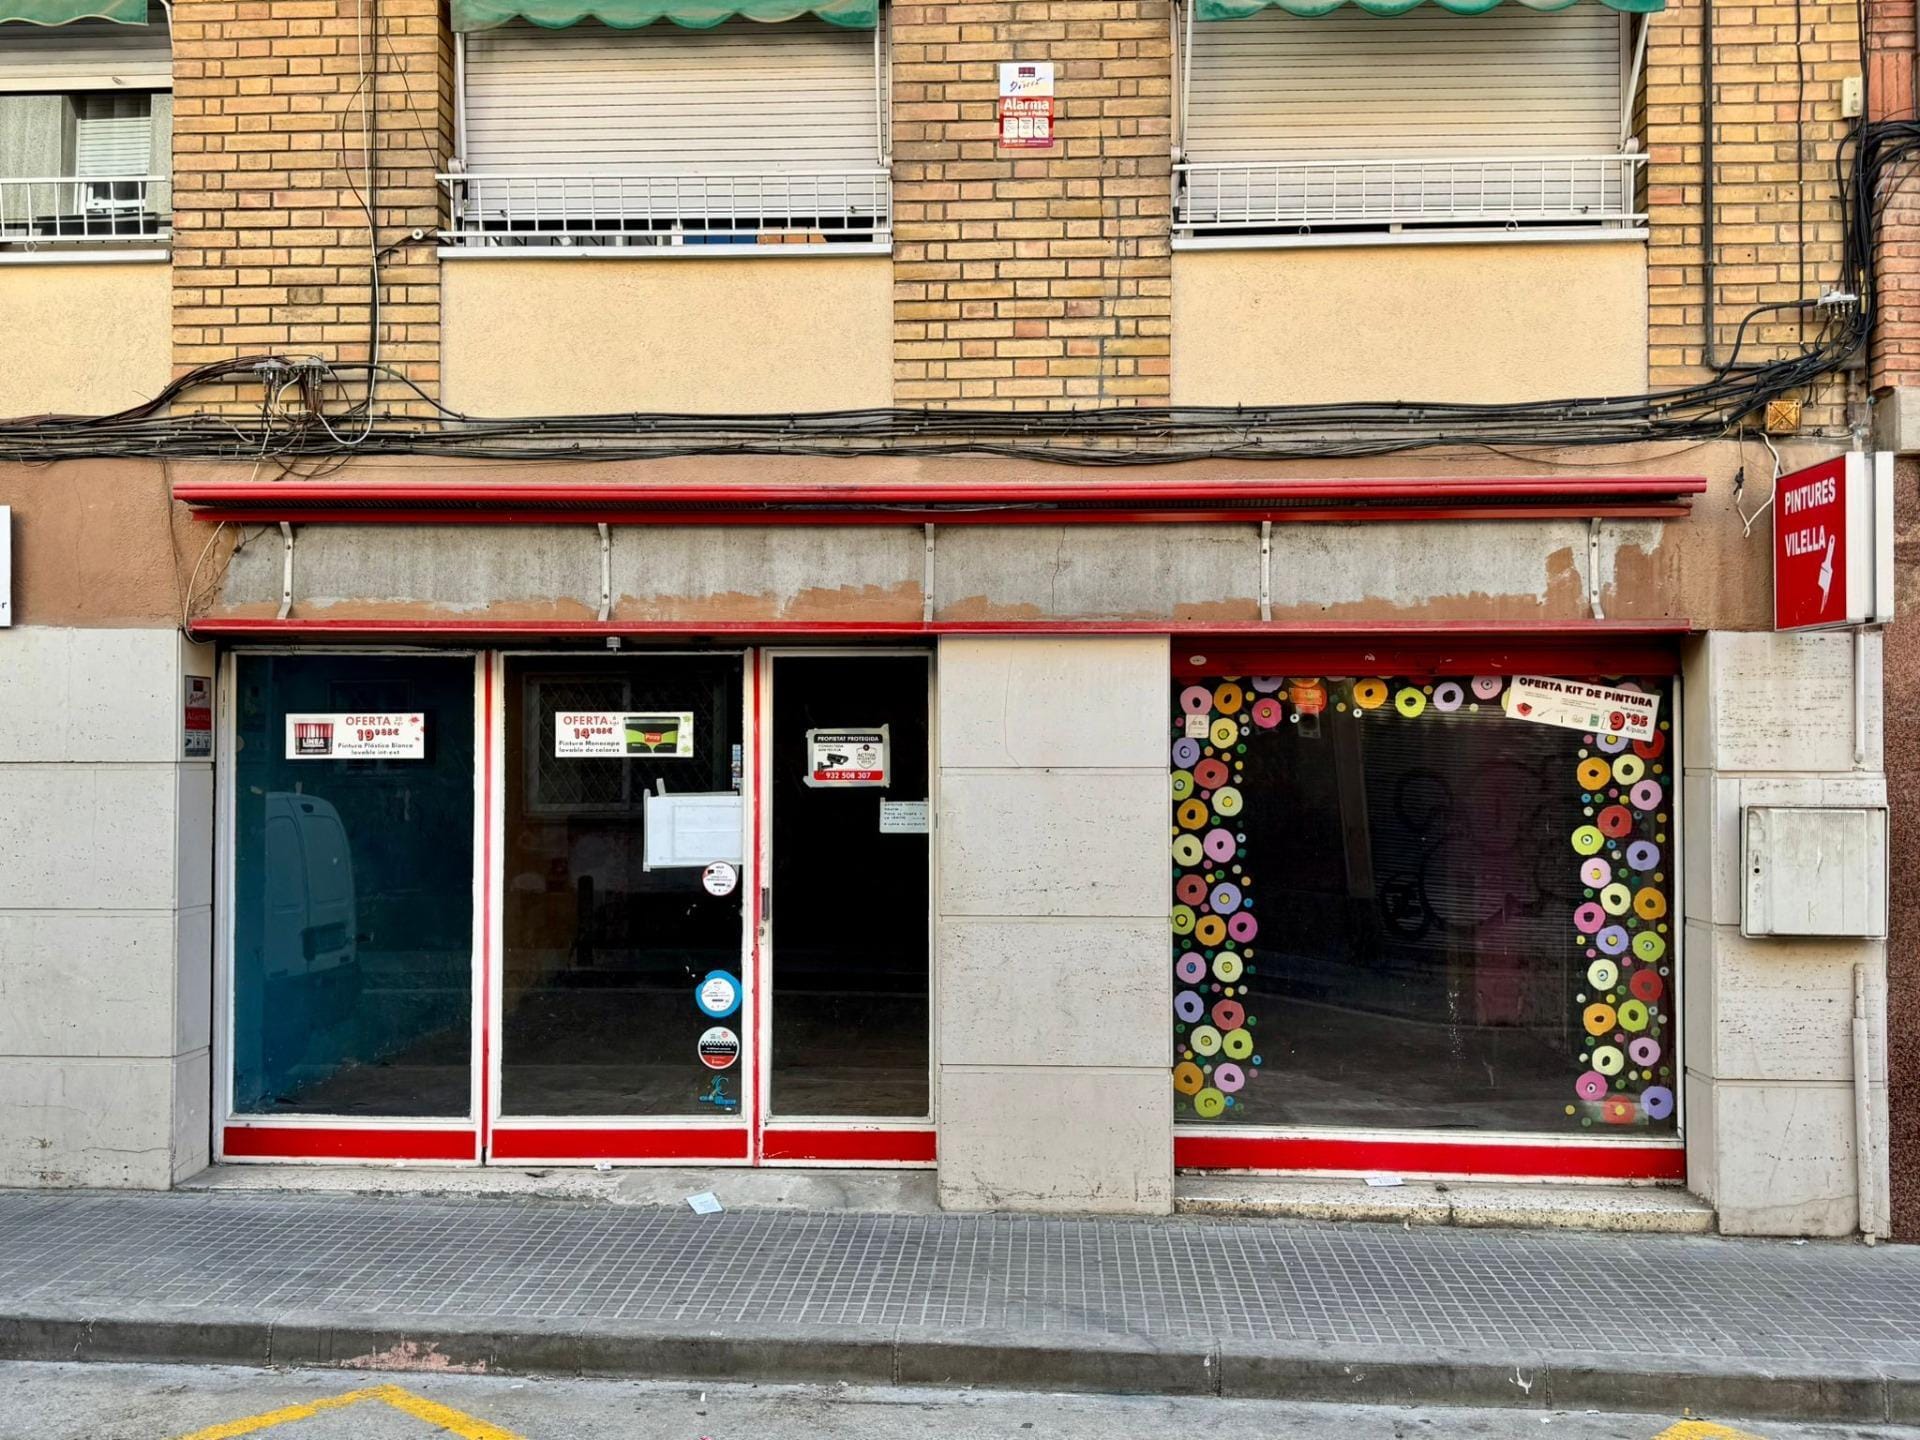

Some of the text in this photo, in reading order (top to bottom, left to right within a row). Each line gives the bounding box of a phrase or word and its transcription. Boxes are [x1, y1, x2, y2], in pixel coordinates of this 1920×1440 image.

[1004, 98, 1049, 110] Alarma
[1785, 477, 1836, 515] PINTURES
[1785, 525, 1826, 557] VILELLA
[1519, 677, 1563, 692] OFERTA
[1565, 684, 1584, 695] KIT
[1586, 688, 1602, 698] DE
[1604, 691, 1653, 708] PINTURA
[346, 716, 391, 726] OFERTA
[563, 716, 608, 725] OFERTA
